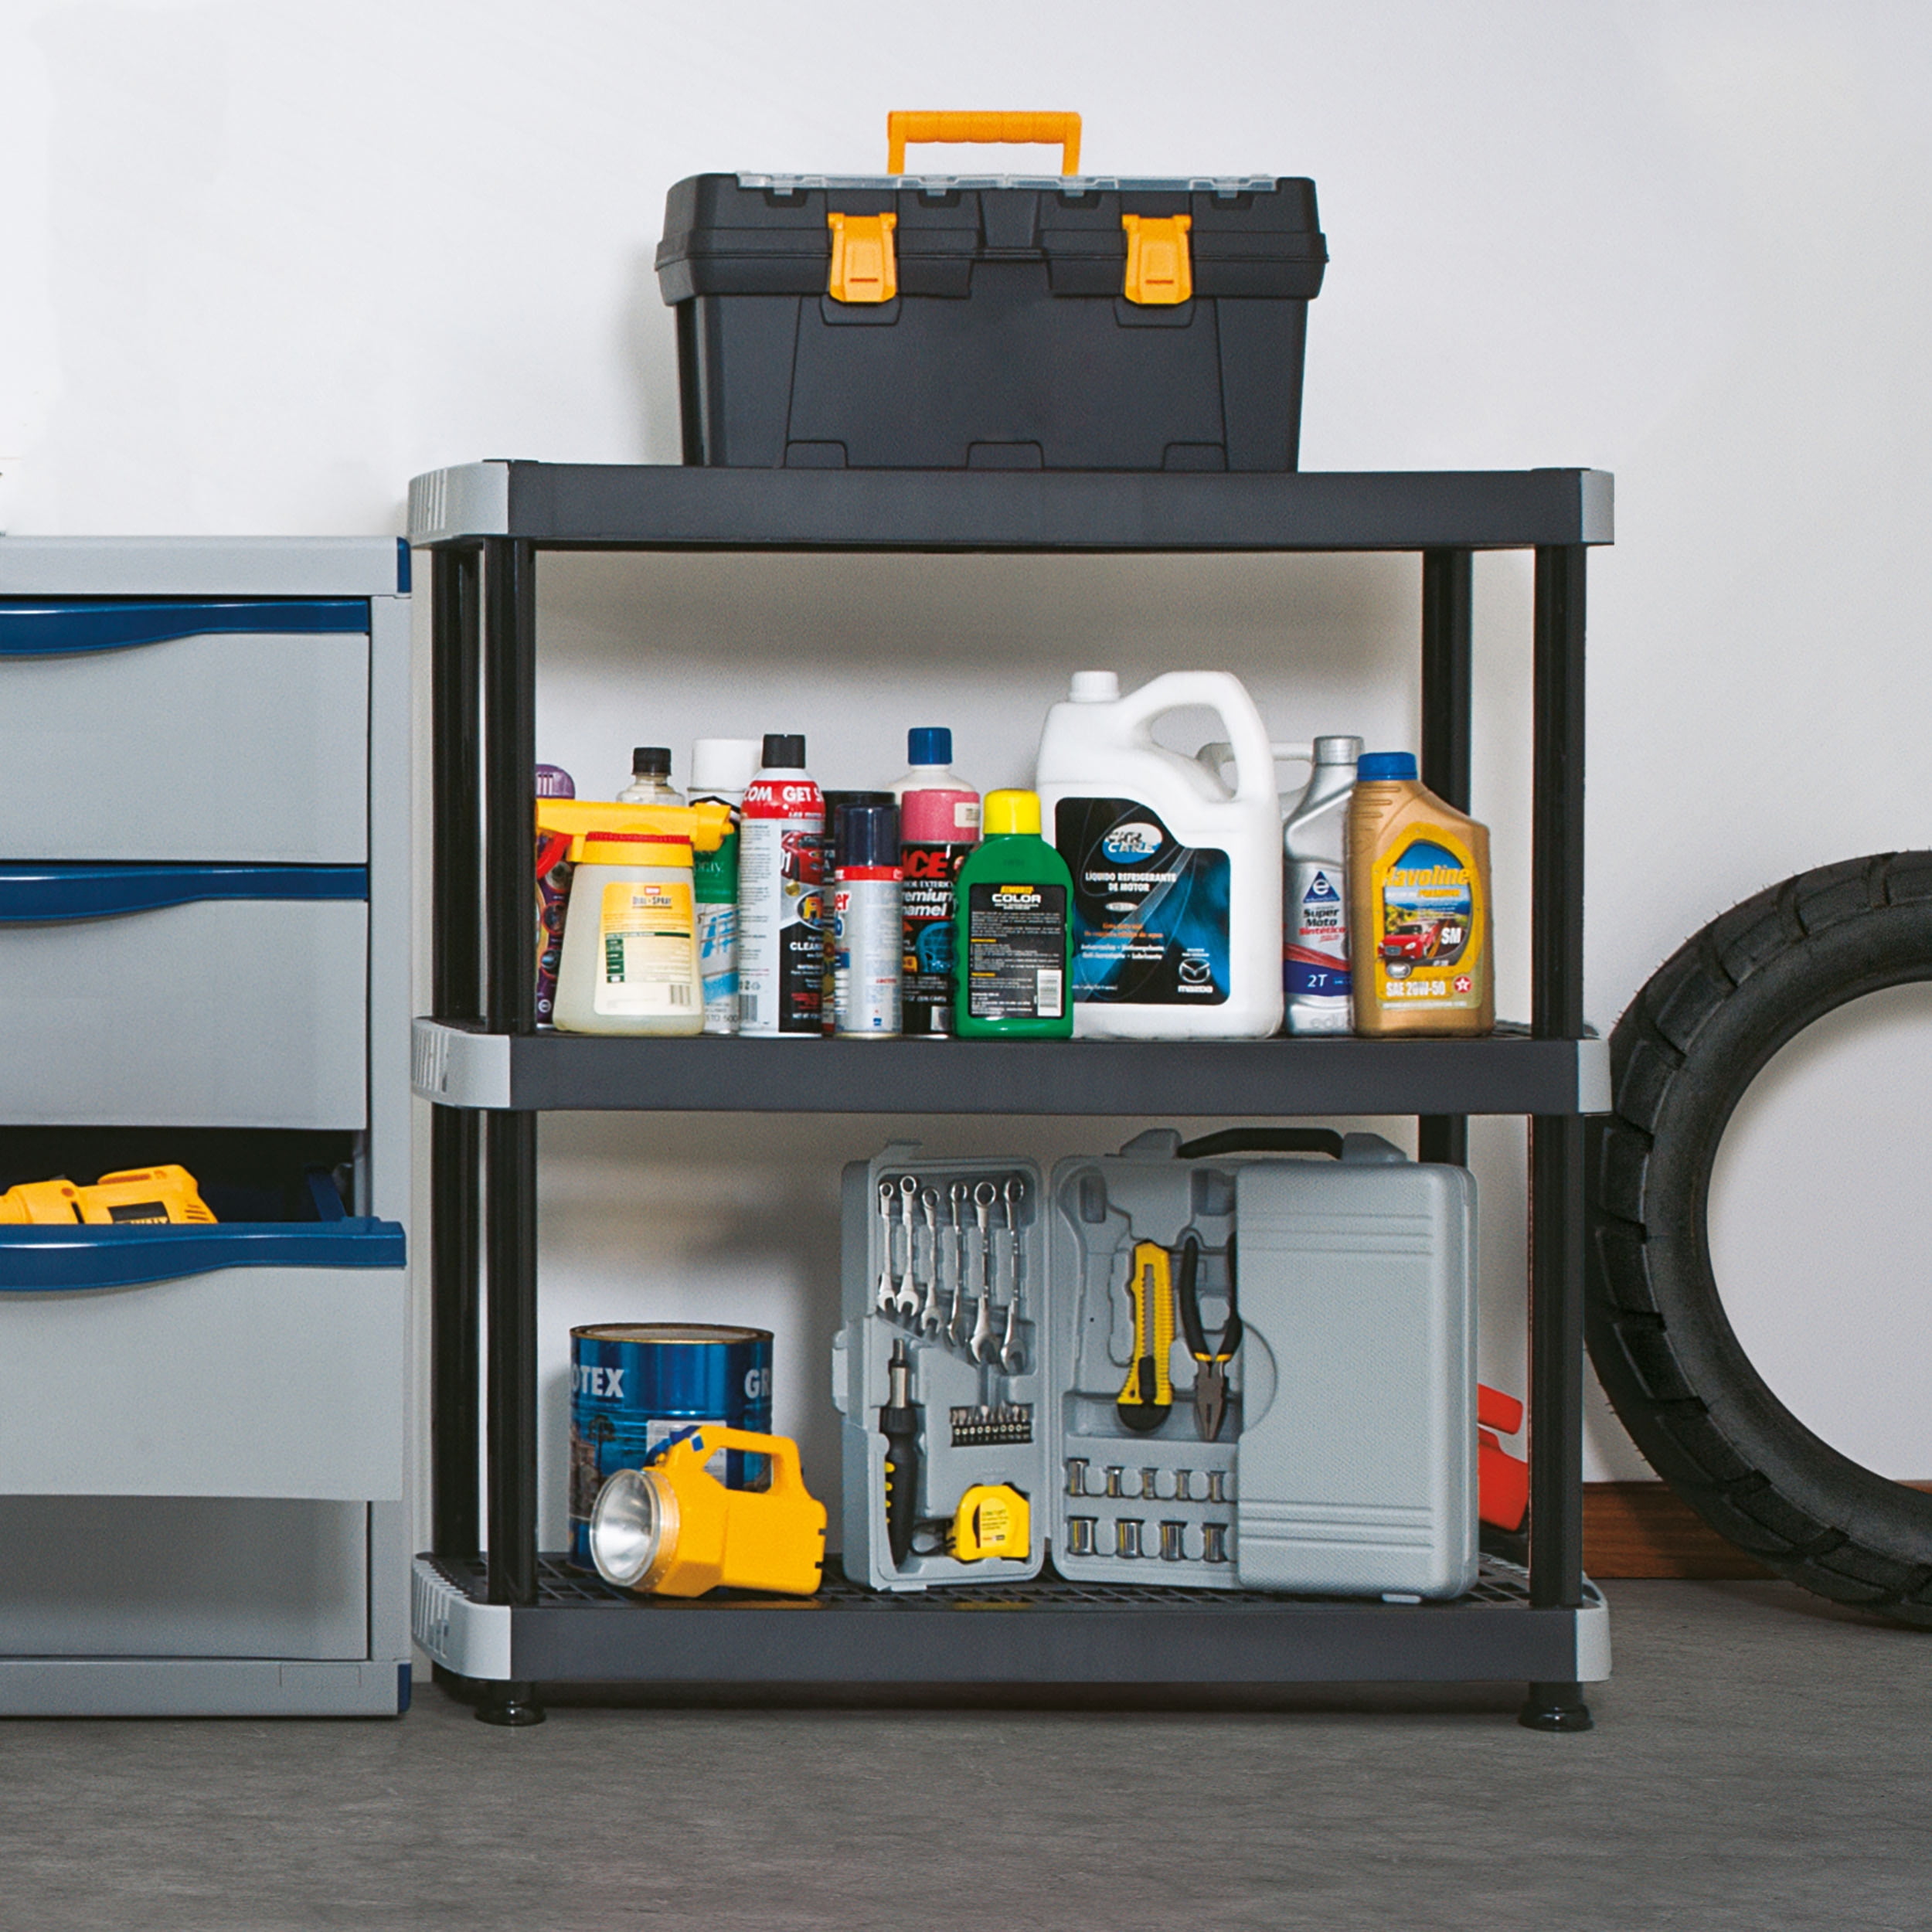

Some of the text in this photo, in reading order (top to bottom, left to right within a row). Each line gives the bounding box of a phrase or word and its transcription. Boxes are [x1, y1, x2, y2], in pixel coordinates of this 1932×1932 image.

[782, 785, 811, 801] GET
[1107, 842, 1156, 853] CARE
[1382, 864, 1471, 887] Havoline
[1120, 883, 1151, 893] MOTOR
[992, 893, 1042, 903] COLOR
[1304, 909, 1339, 919] Super
[1306, 918, 1338, 927] Moto
[1441, 927, 1462, 944] SM
[1306, 974, 1328, 988] 2T
[1386, 980, 1446, 997] SAE 20W-50
